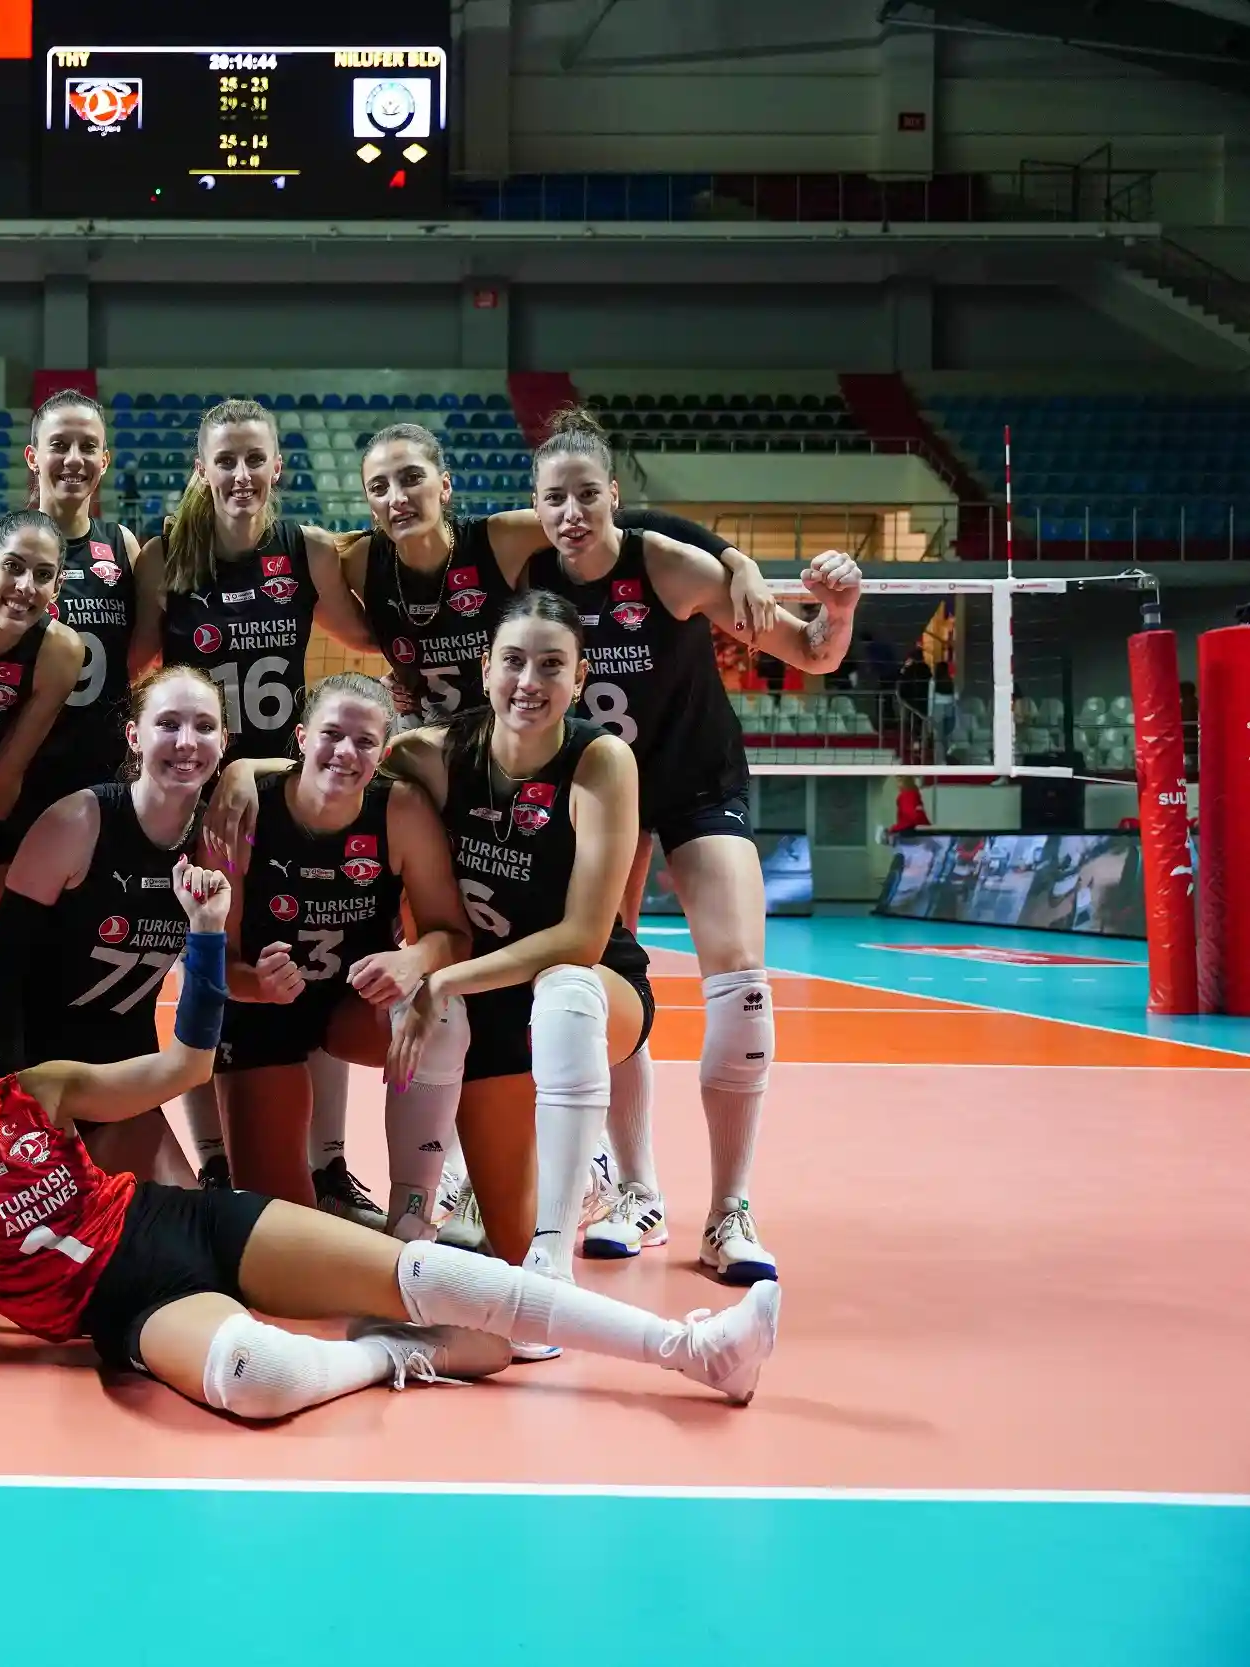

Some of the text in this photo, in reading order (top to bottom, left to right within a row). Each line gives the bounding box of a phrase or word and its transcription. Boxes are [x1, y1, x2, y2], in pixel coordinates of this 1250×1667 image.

[56, 52, 90, 67] THY
[407, 52, 441, 67] BLD
[64, 599, 125, 612] TURKISH
[66, 612, 127, 626] AIRLINES
[227, 619, 297, 636] TURKISH
[228, 633, 297, 650] AIRLINES
[419, 630, 488, 651] TURKISH
[583, 645, 650, 660] TURKISH
[65, 632, 107, 707] 9
[209, 656, 294, 734] 16
[420, 665, 461, 714] 5
[584, 682, 638, 745] 8
[460, 836, 533, 867] TURKISH
[456, 851, 531, 882] AIRLINES
[304, 895, 376, 913] TURKISH
[304, 907, 376, 925] AIRLINES
[298, 929, 344, 981] 3
[67, 945, 179, 1015] 77
[5, 1180, 78, 1237] AIRLINES
